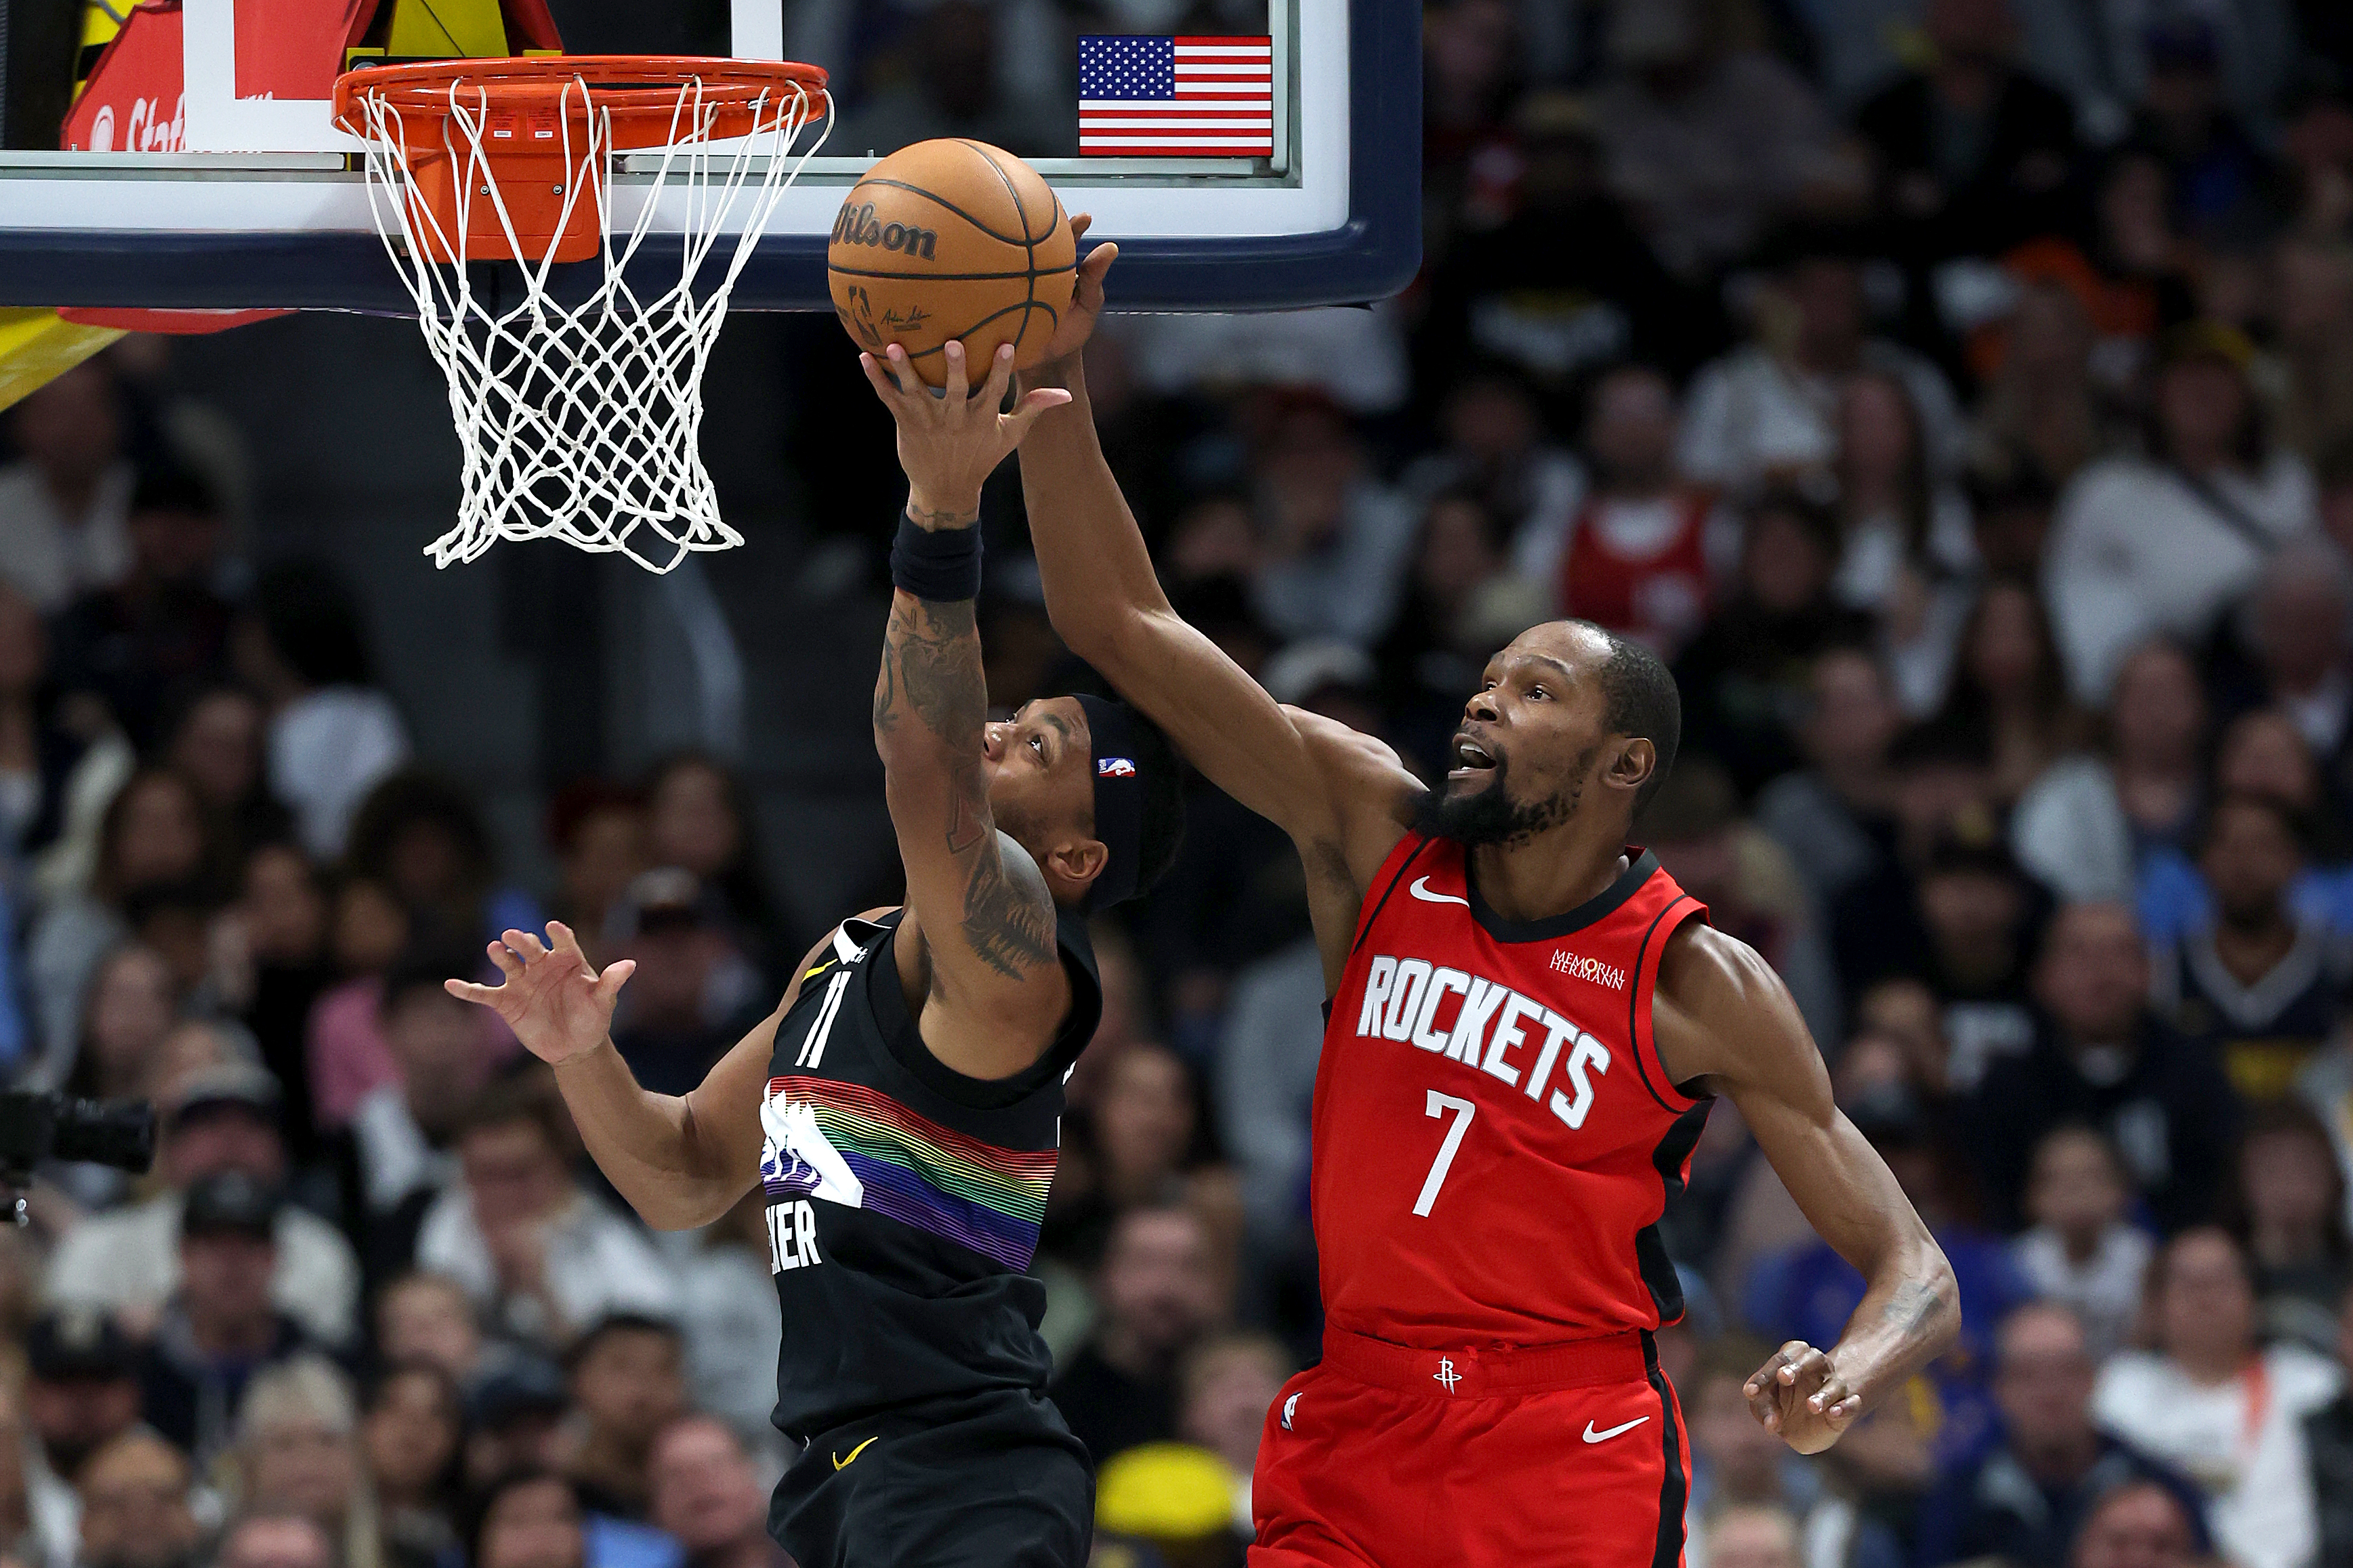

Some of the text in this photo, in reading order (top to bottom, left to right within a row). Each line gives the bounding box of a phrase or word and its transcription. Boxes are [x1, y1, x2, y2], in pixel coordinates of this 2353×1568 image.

[1549, 957, 1624, 991] HERMANN
[1552, 948, 1625, 982] MEMORIAL
[1356, 954, 1611, 1130] ROCKETS
[1412, 1089, 1476, 1218] 7
